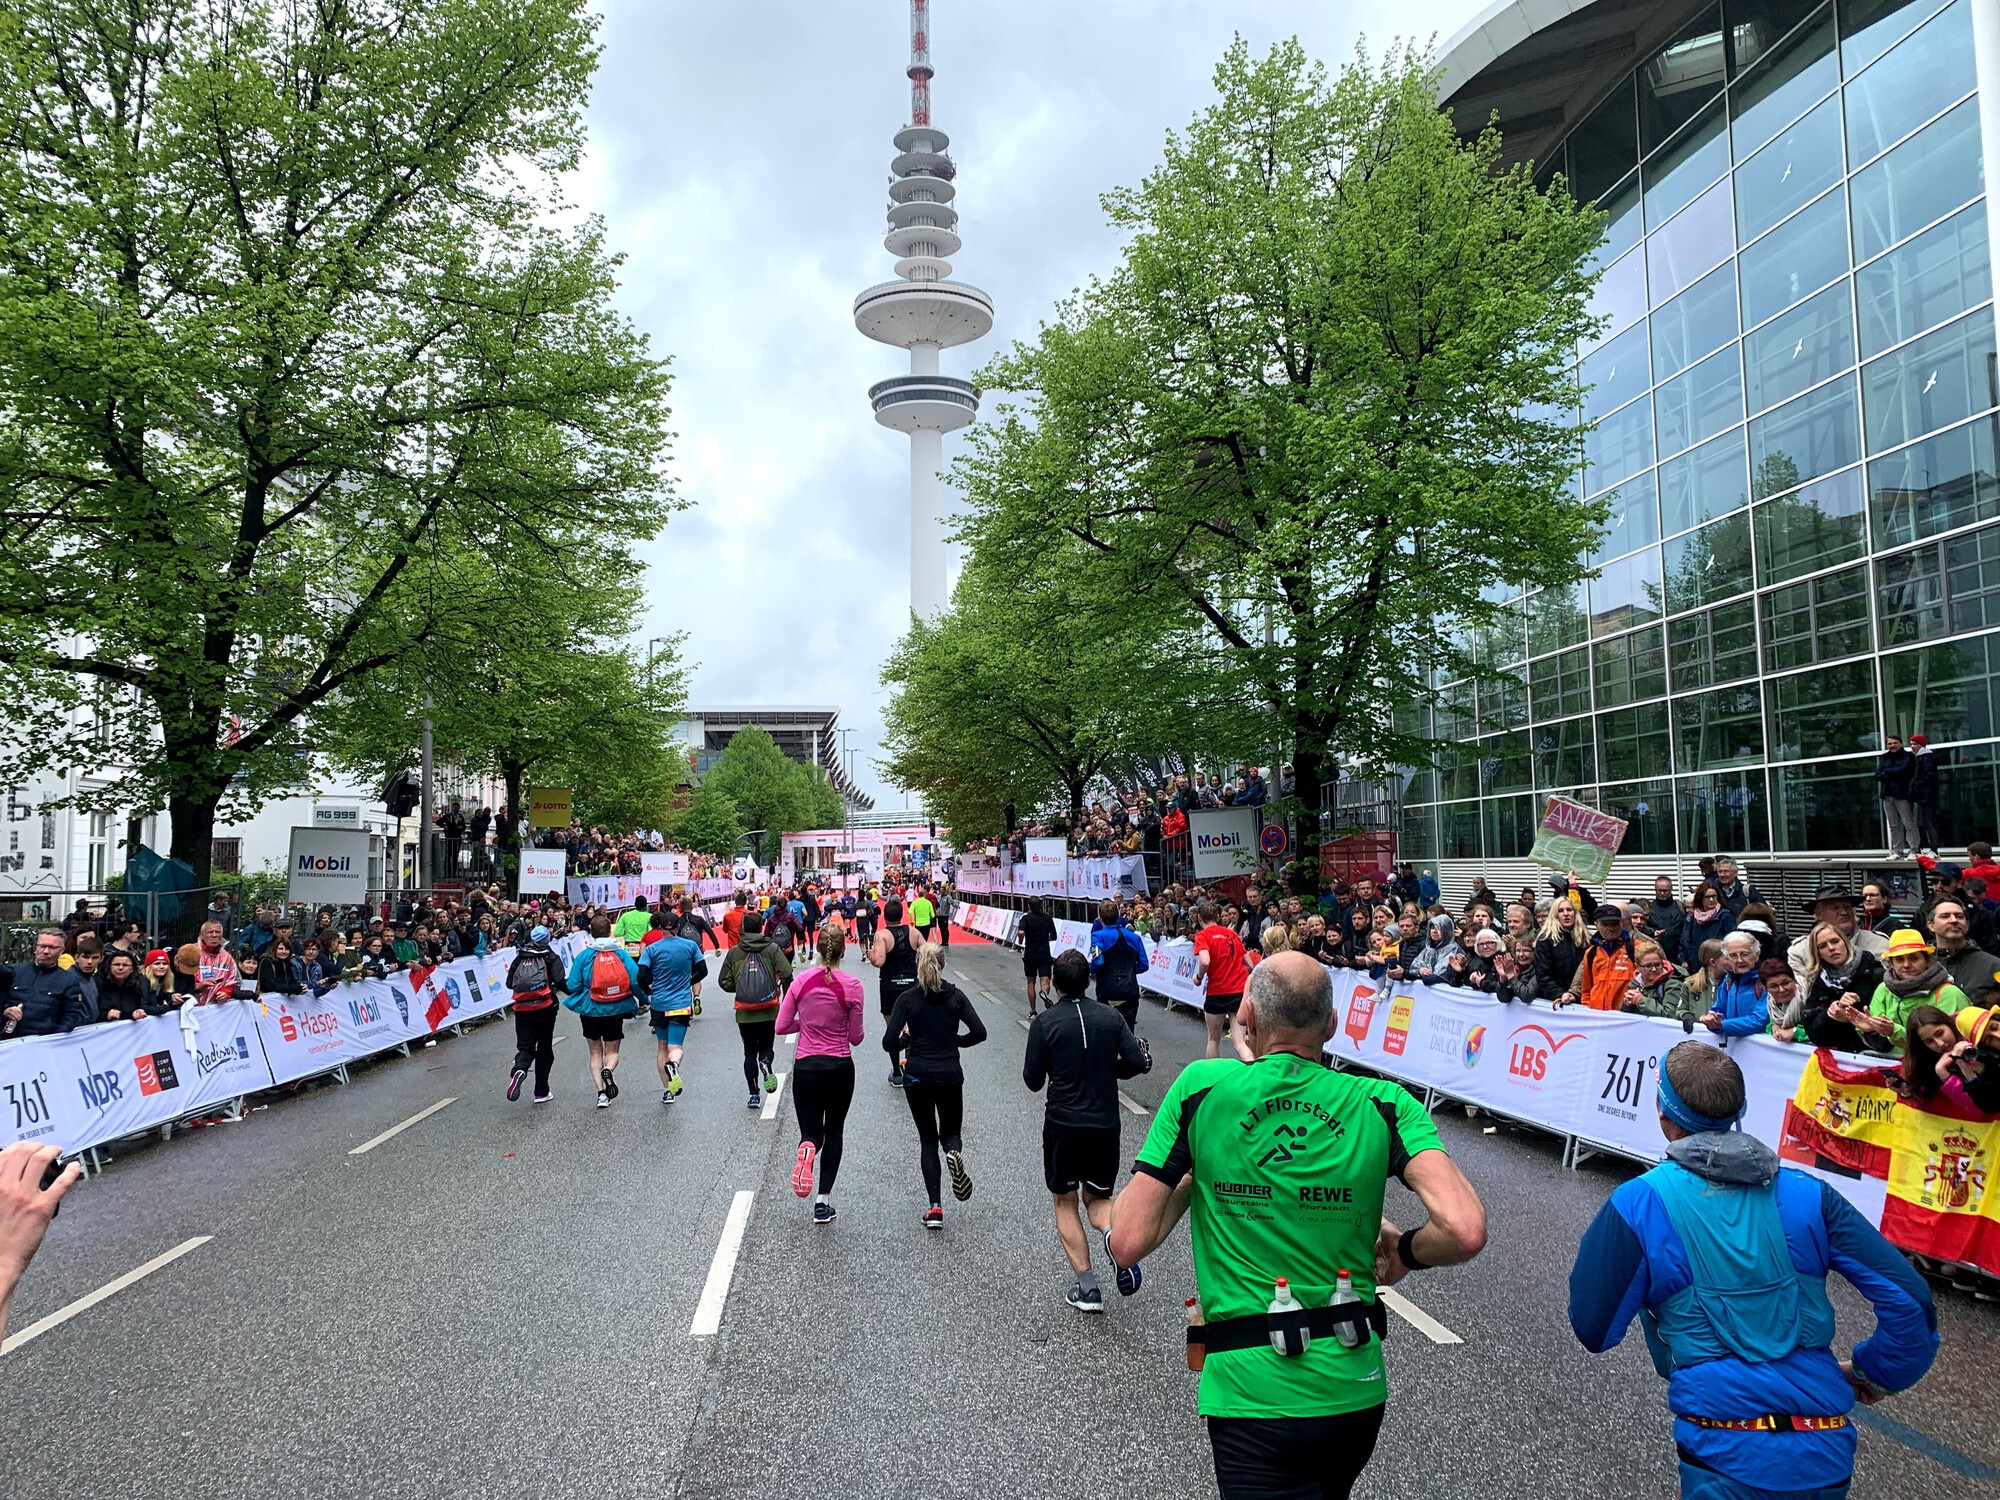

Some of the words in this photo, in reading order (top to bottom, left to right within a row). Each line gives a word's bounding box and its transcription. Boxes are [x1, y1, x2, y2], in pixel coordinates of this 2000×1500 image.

[316, 810, 332, 819] AG
[333, 810, 356, 819] 999
[1544, 802, 1620, 848] ANIKA
[1197, 832, 1240, 848] Mobil
[298, 855, 350, 871] Mobil
[1543, 834, 1607, 880] GO!
[537, 867, 559, 875] Haspa
[348, 996, 381, 1027] Mobil
[1353, 995, 1372, 1013] REWE
[297, 1012, 339, 1037] Haspa
[1429, 1014, 1464, 1037] MERKUR
[1430, 1034, 1460, 1056] DRUCK
[1508, 1043, 1548, 1081] LBS
[78, 1070, 123, 1110] NDR
[1601, 1053, 1657, 1108] 361°
[3, 1071, 47, 1129] 361°
[1239, 1107, 1261, 1133] LT
[1264, 1096, 1346, 1140] Florstadt
[1605, 1106, 1622, 1118] DEGREE
[1621, 1109, 1638, 1122] BEYOND
[1214, 1180, 1273, 1200] HÜBNER
[1299, 1186, 1353, 1203] REWE
[1215, 1196, 1270, 1208] Natursteine
[1299, 1203, 1351, 1211] Florstadt
